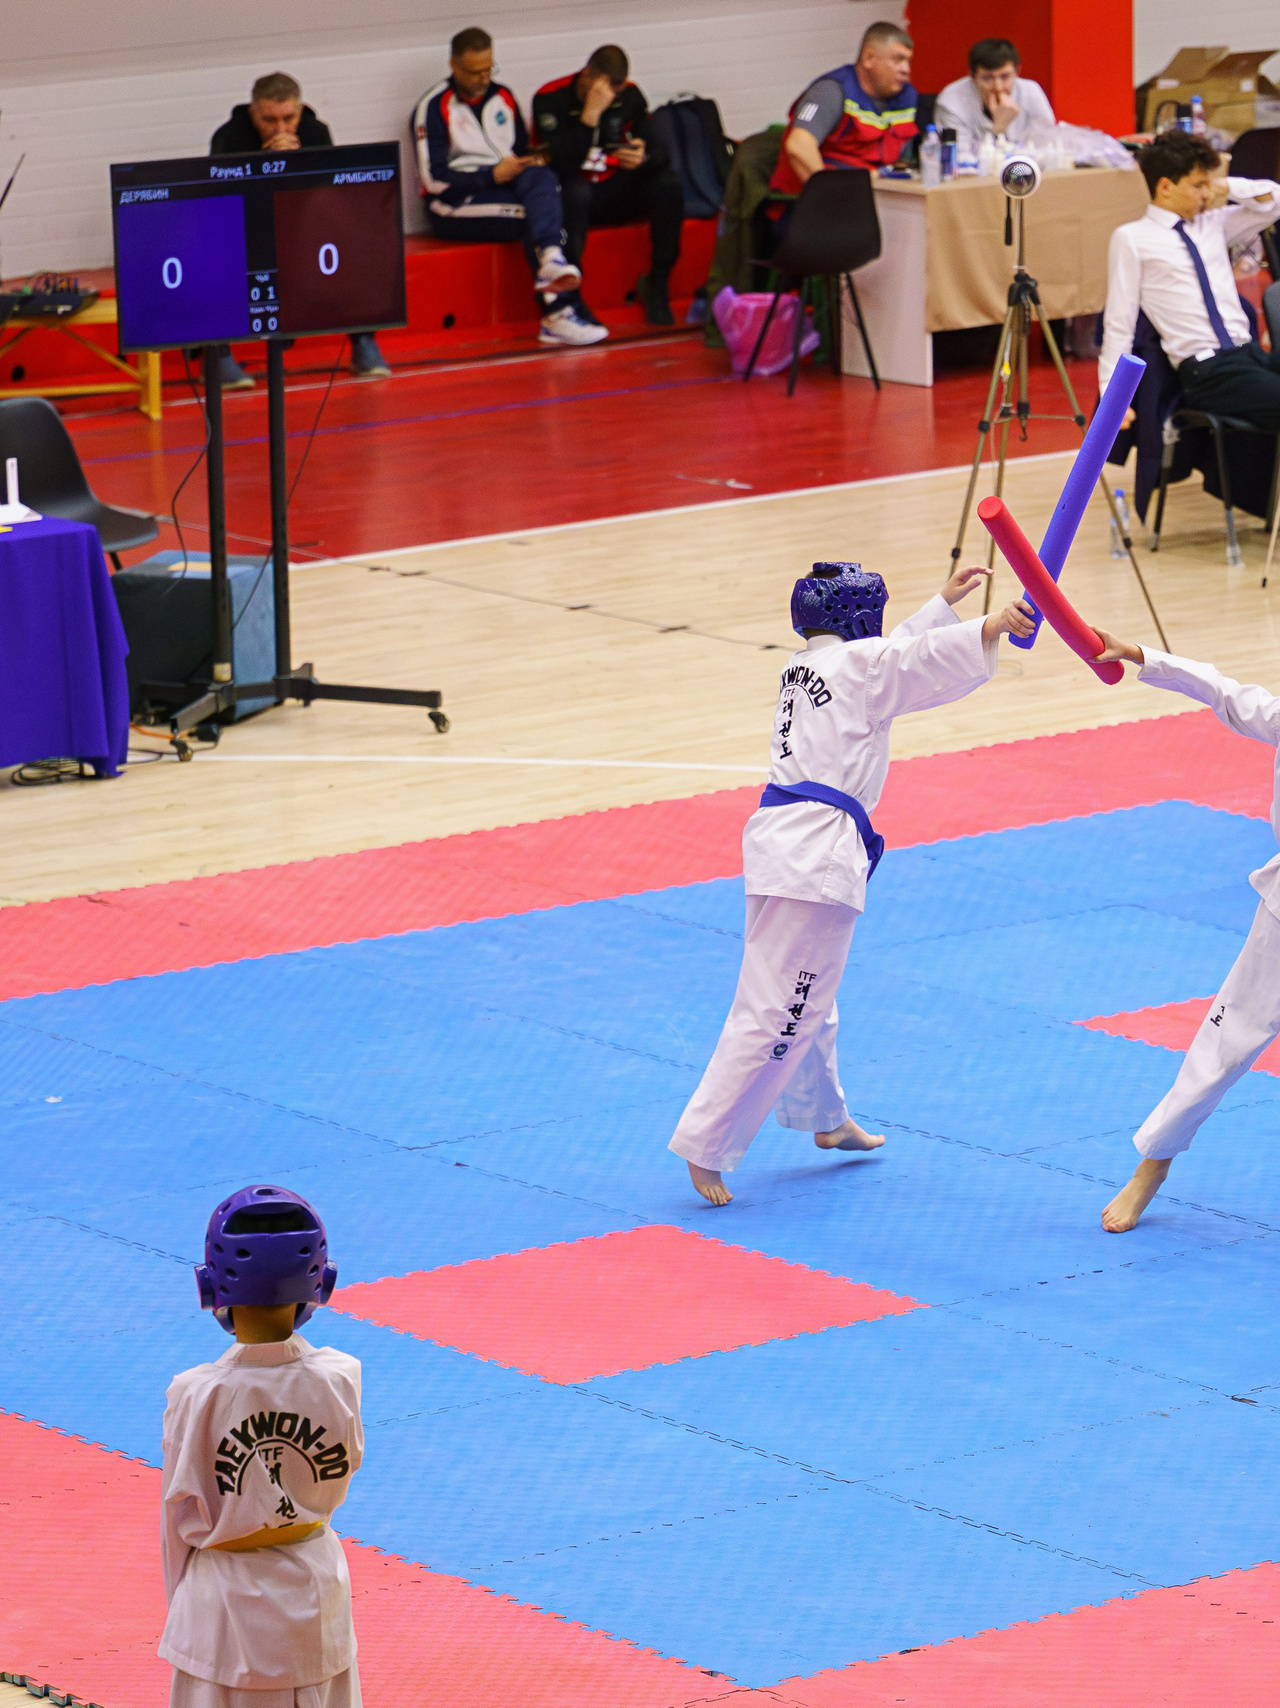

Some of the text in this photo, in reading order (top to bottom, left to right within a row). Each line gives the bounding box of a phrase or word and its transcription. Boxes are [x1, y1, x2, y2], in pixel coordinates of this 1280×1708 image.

[245, 163, 252, 176] 1
[262, 160, 287, 174] 0:27
[318, 243, 339, 276] 0
[162, 257, 183, 290] 0
[251, 285, 276, 301] 0 1
[252, 316, 278, 333] 0 0
[799, 970, 818, 983] ITF
[214, 1411, 350, 1497] TAEKWON-DO
